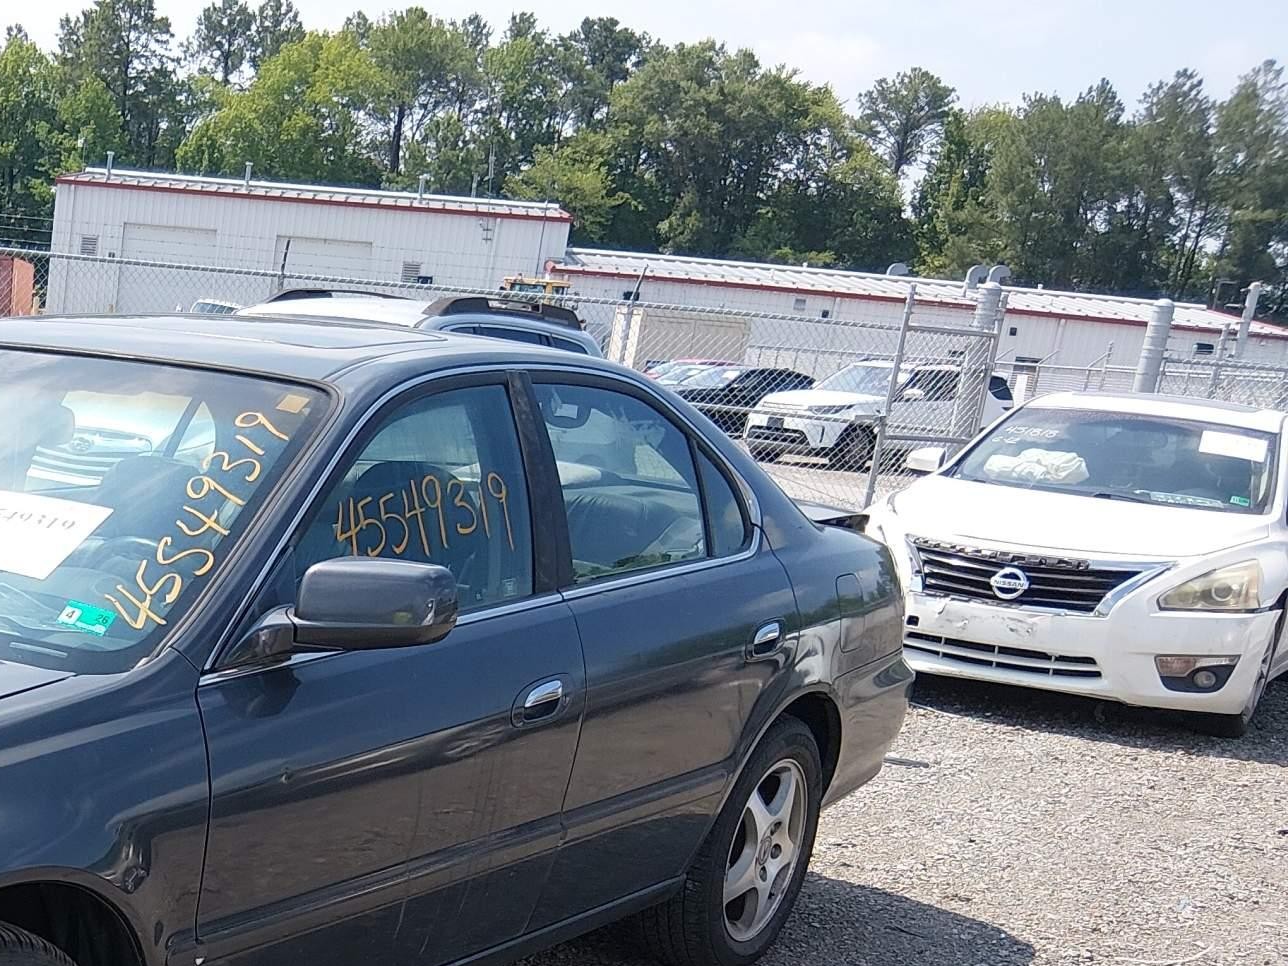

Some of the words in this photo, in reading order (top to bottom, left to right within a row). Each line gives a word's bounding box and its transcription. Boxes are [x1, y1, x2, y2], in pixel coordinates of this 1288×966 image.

[104, 411, 289, 630] 45549319
[334, 472, 515, 558] 45549319
[993, 579, 1025, 588] NISSAN
